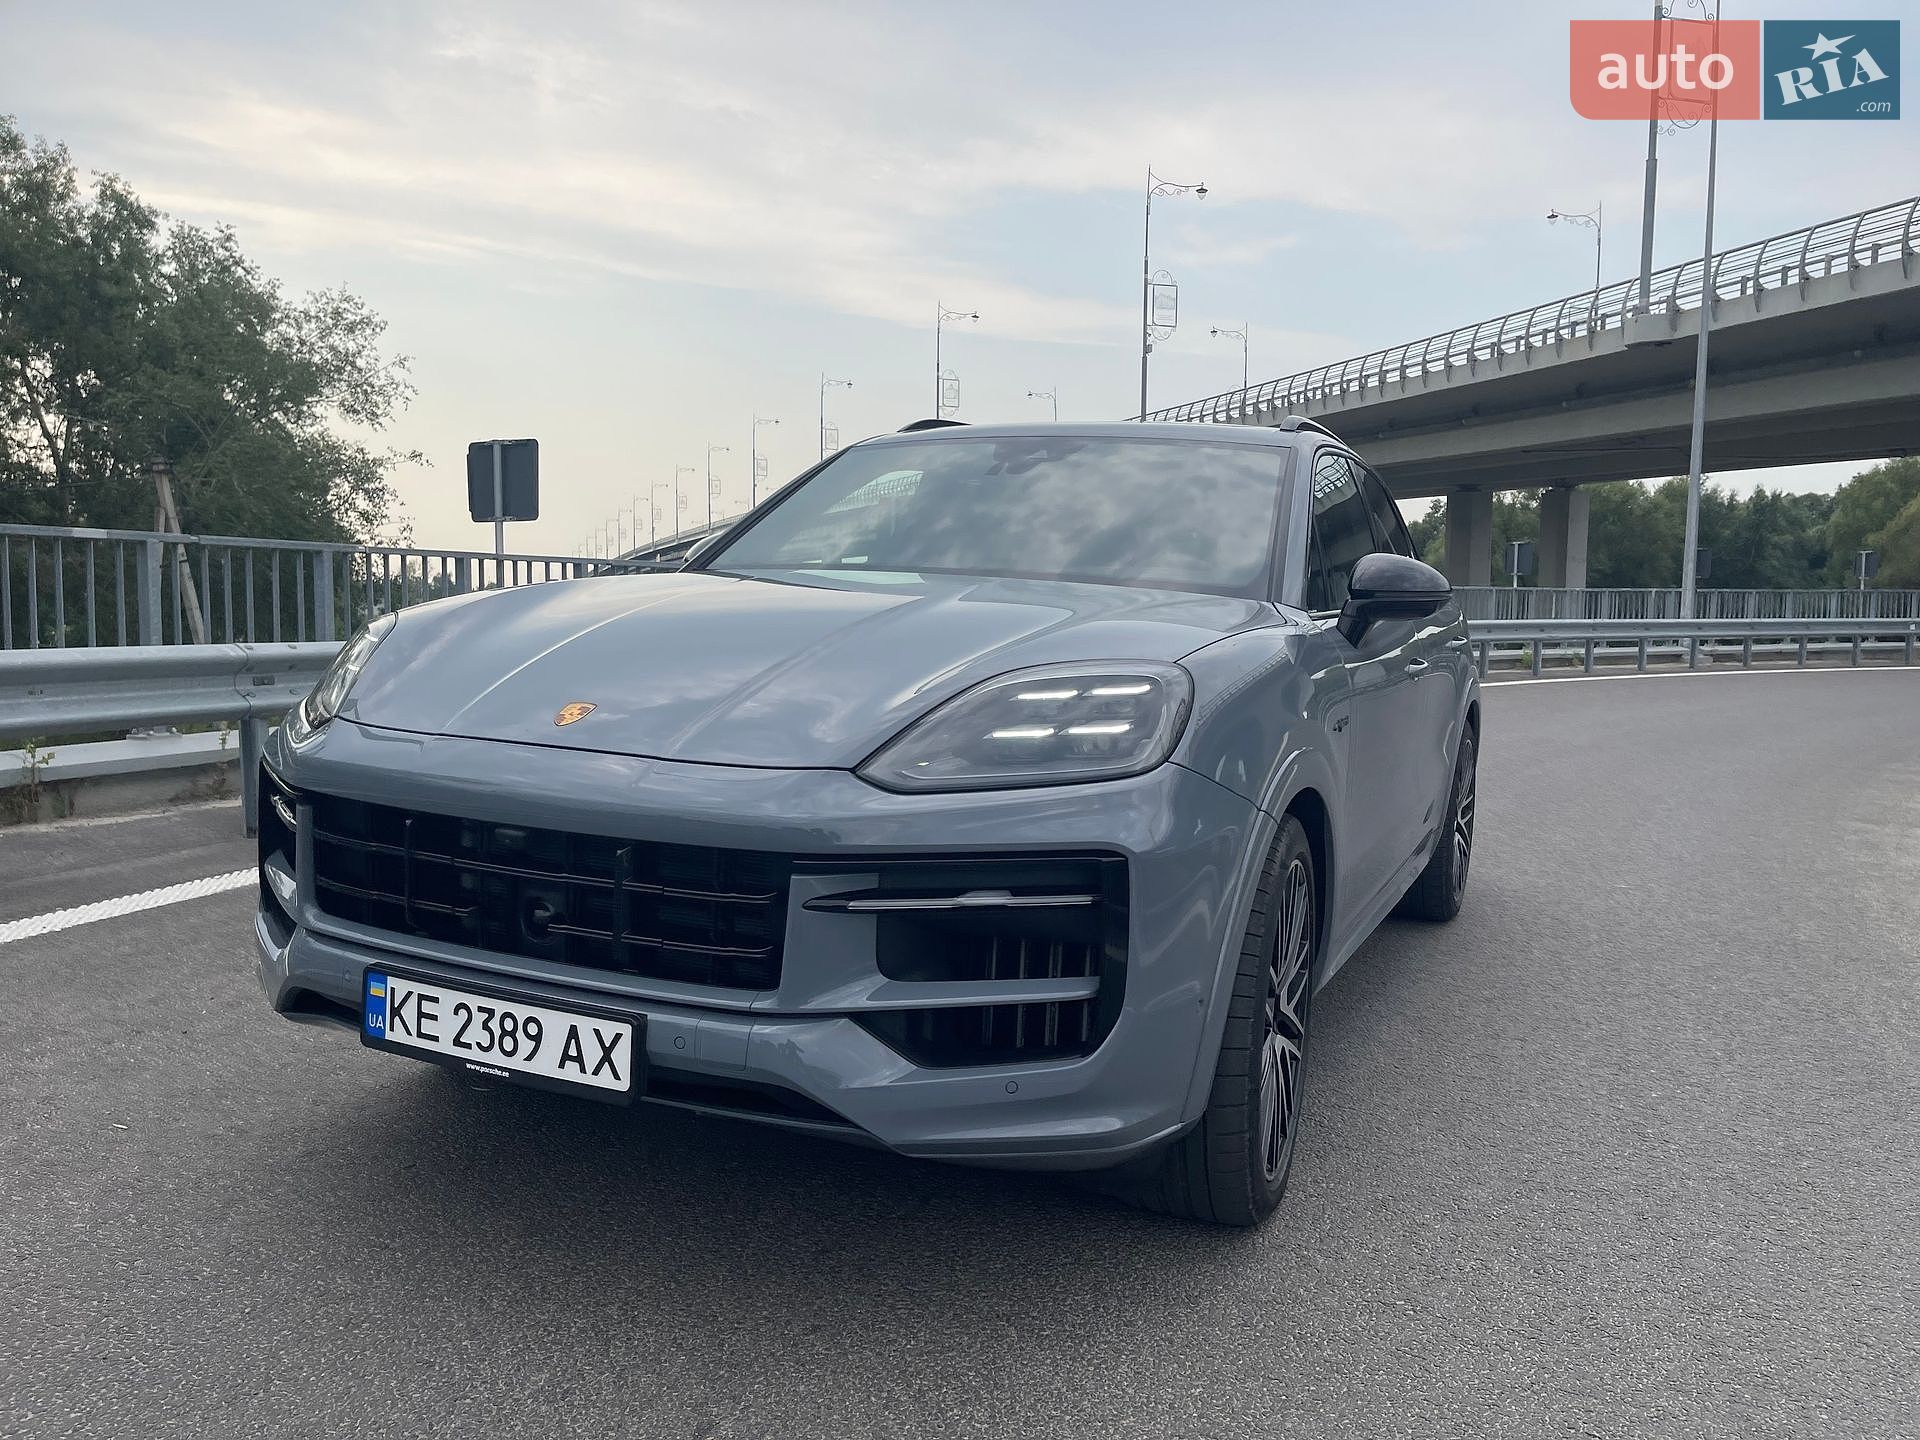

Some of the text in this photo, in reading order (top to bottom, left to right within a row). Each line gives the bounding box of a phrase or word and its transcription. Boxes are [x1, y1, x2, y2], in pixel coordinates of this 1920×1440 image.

[368, 1012, 385, 1030] UA
[389, 986, 624, 1081] KE 2389 AX
